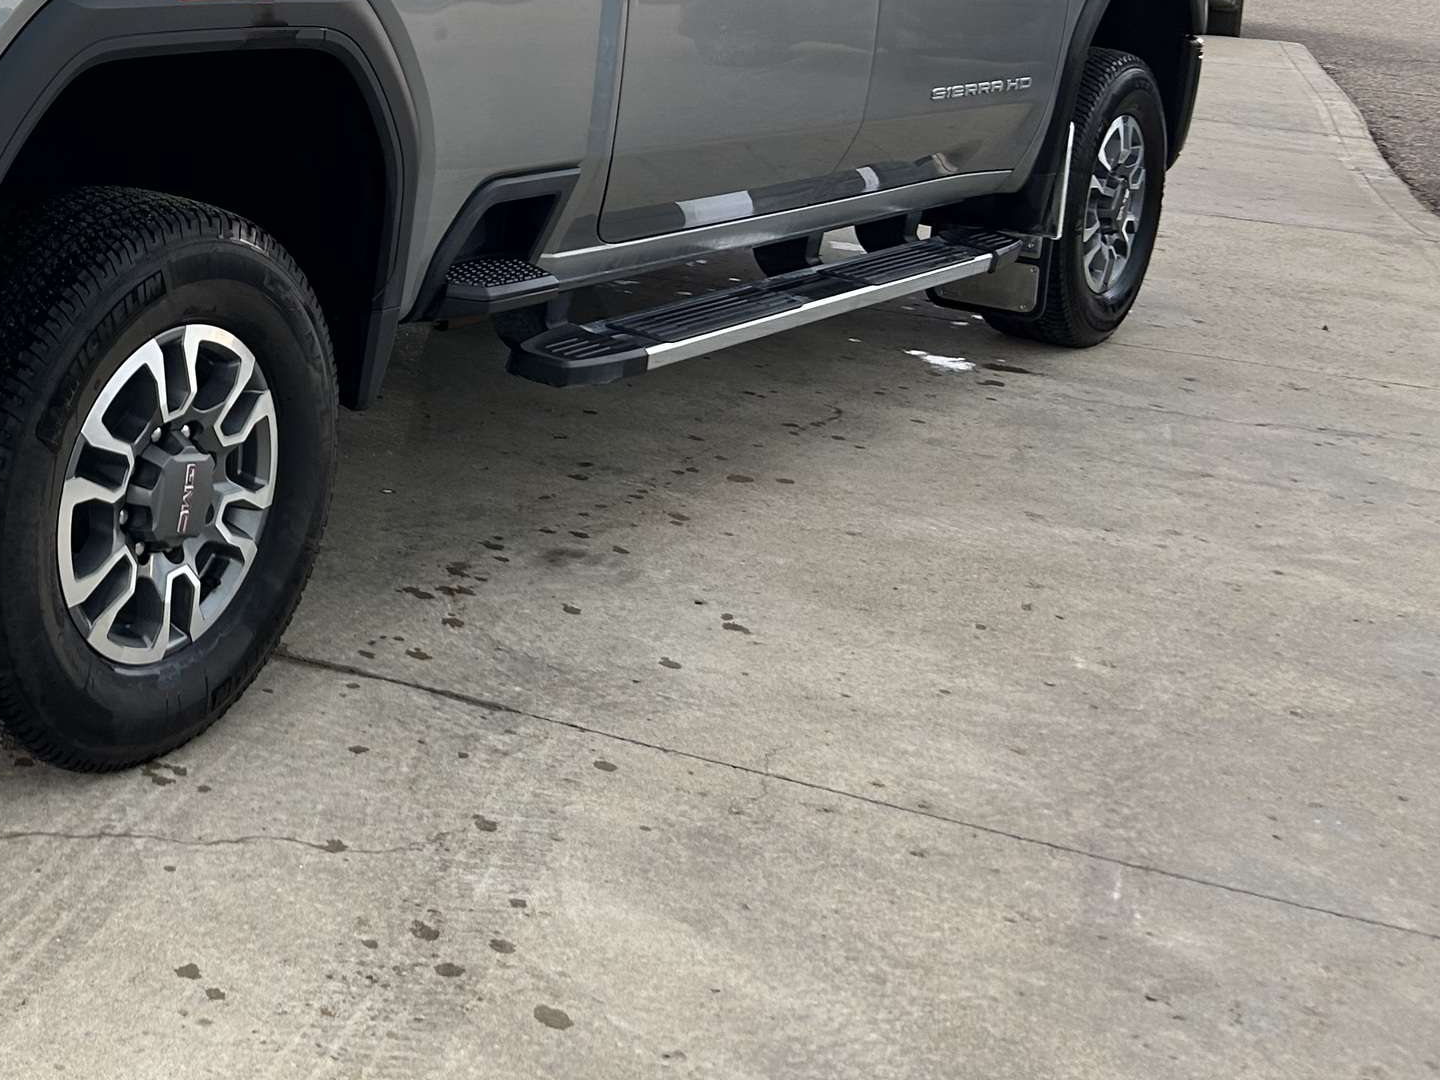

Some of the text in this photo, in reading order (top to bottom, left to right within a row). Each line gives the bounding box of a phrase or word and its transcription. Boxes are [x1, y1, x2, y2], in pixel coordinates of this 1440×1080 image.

[930, 76, 1033, 100] SIERRA HD
[177, 463, 196, 533] GMC
